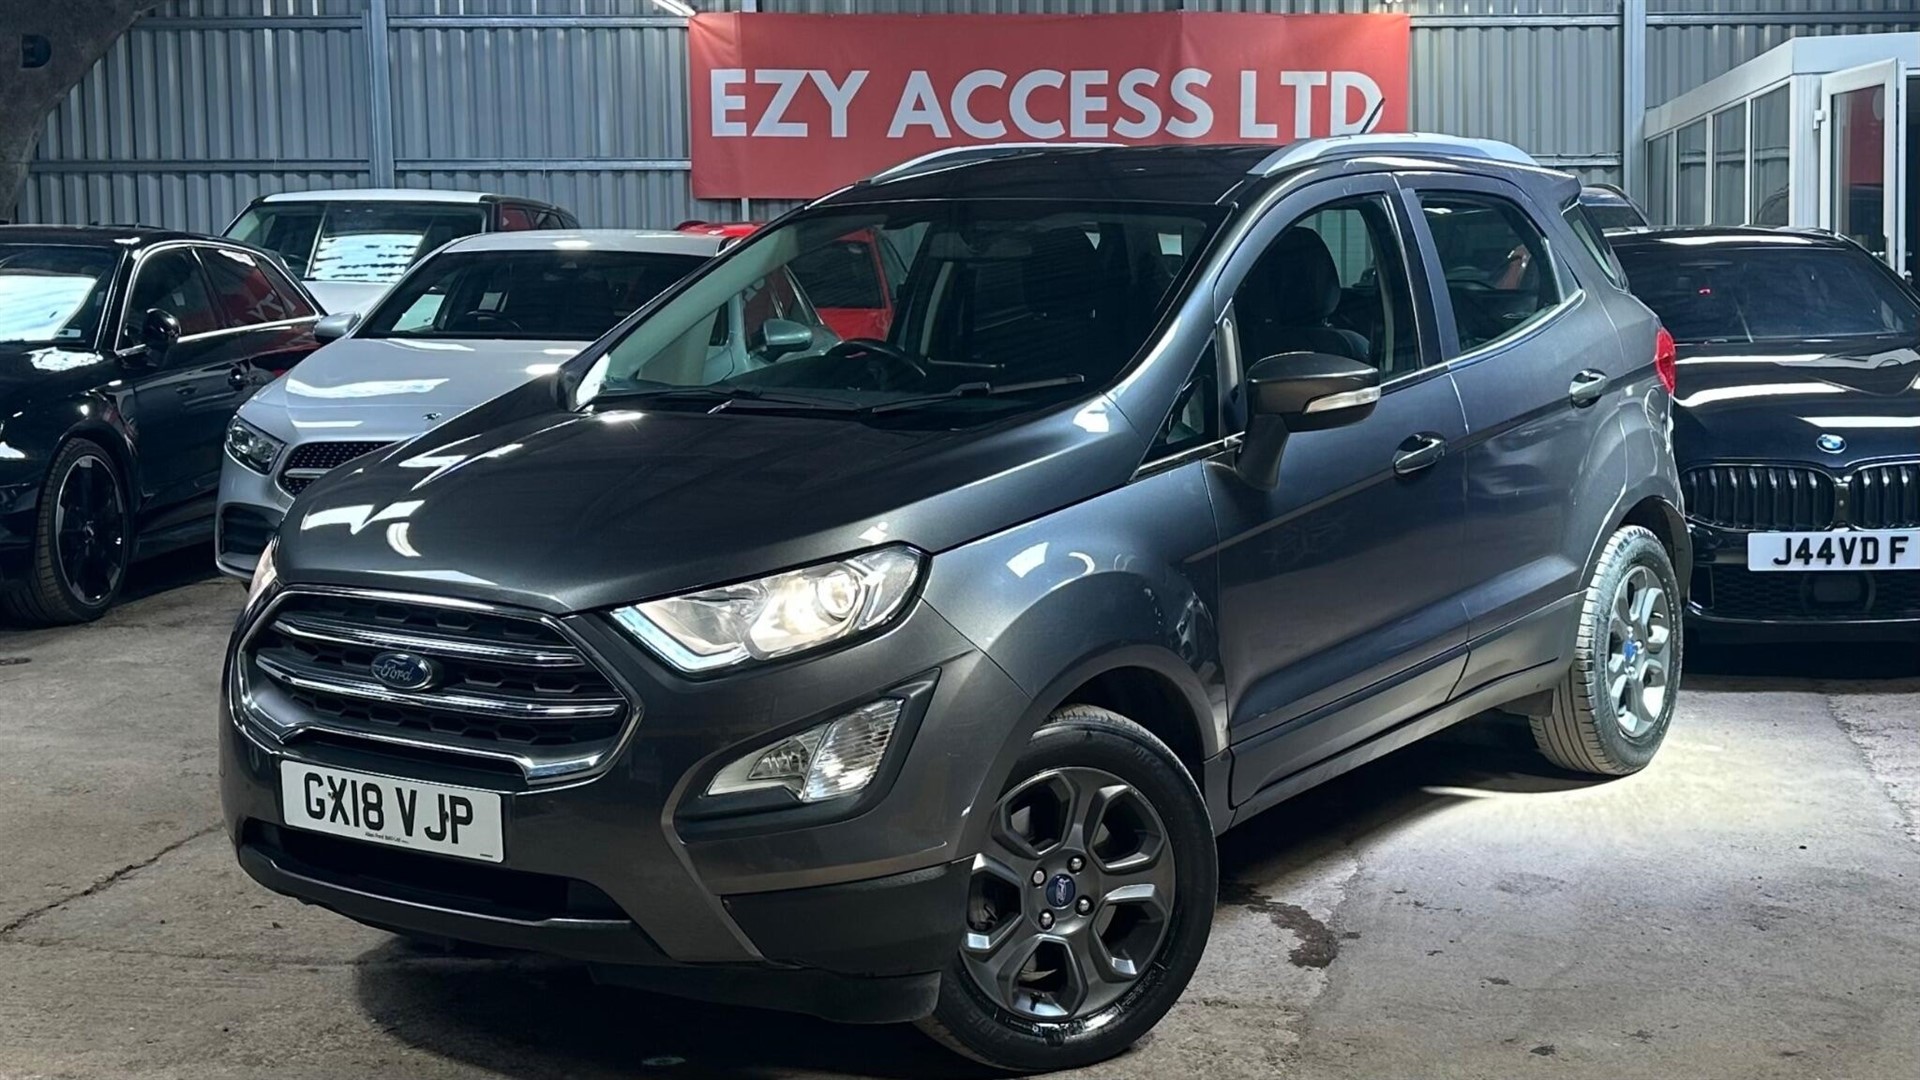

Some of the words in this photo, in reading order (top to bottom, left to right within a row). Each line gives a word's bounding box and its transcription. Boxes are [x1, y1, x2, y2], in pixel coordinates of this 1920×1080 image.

[710, 69, 869, 138] EZY
[887, 69, 1214, 139] ACCESS
[1239, 70, 1384, 139] LTD
[380, 659, 414, 681] Ford
[304, 771, 384, 832] GX18
